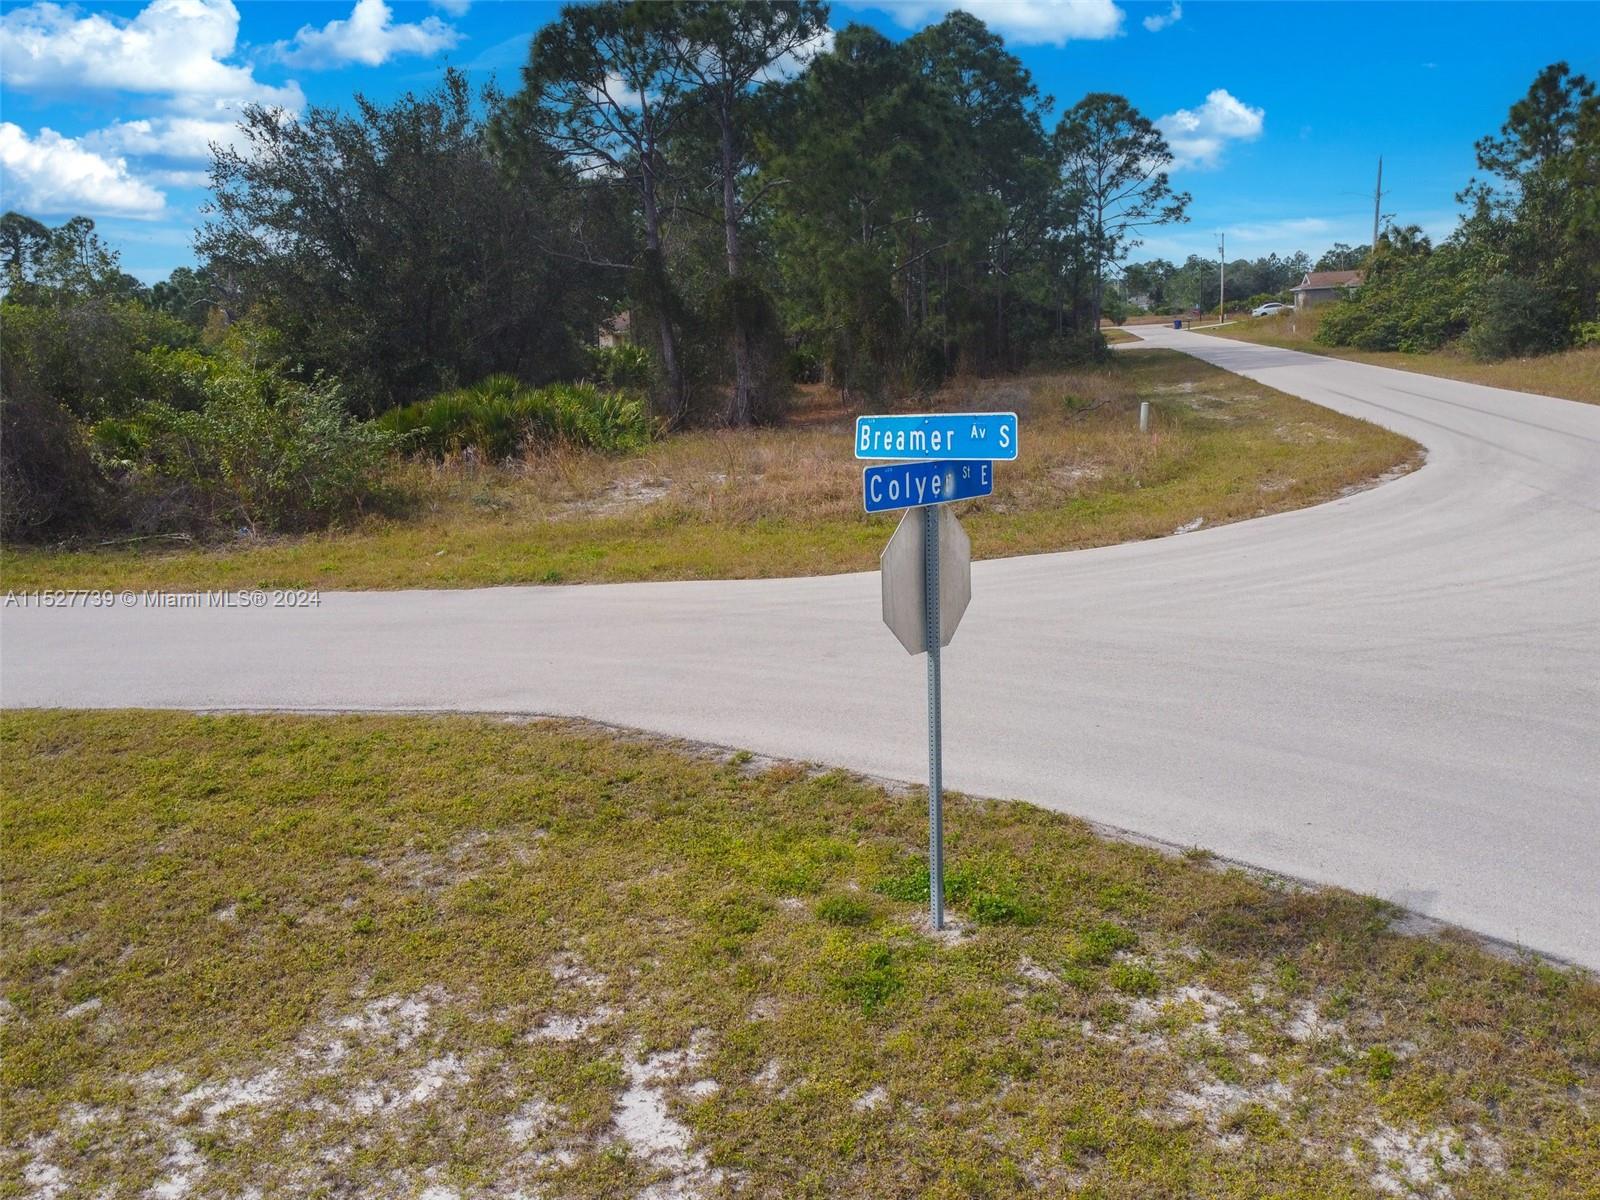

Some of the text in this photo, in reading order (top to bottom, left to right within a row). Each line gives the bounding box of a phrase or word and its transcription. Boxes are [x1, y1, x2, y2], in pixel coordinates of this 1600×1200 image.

[860, 424, 1010, 451] Breamer Av S
[962, 465, 971, 479] St
[981, 465, 988, 485] E
